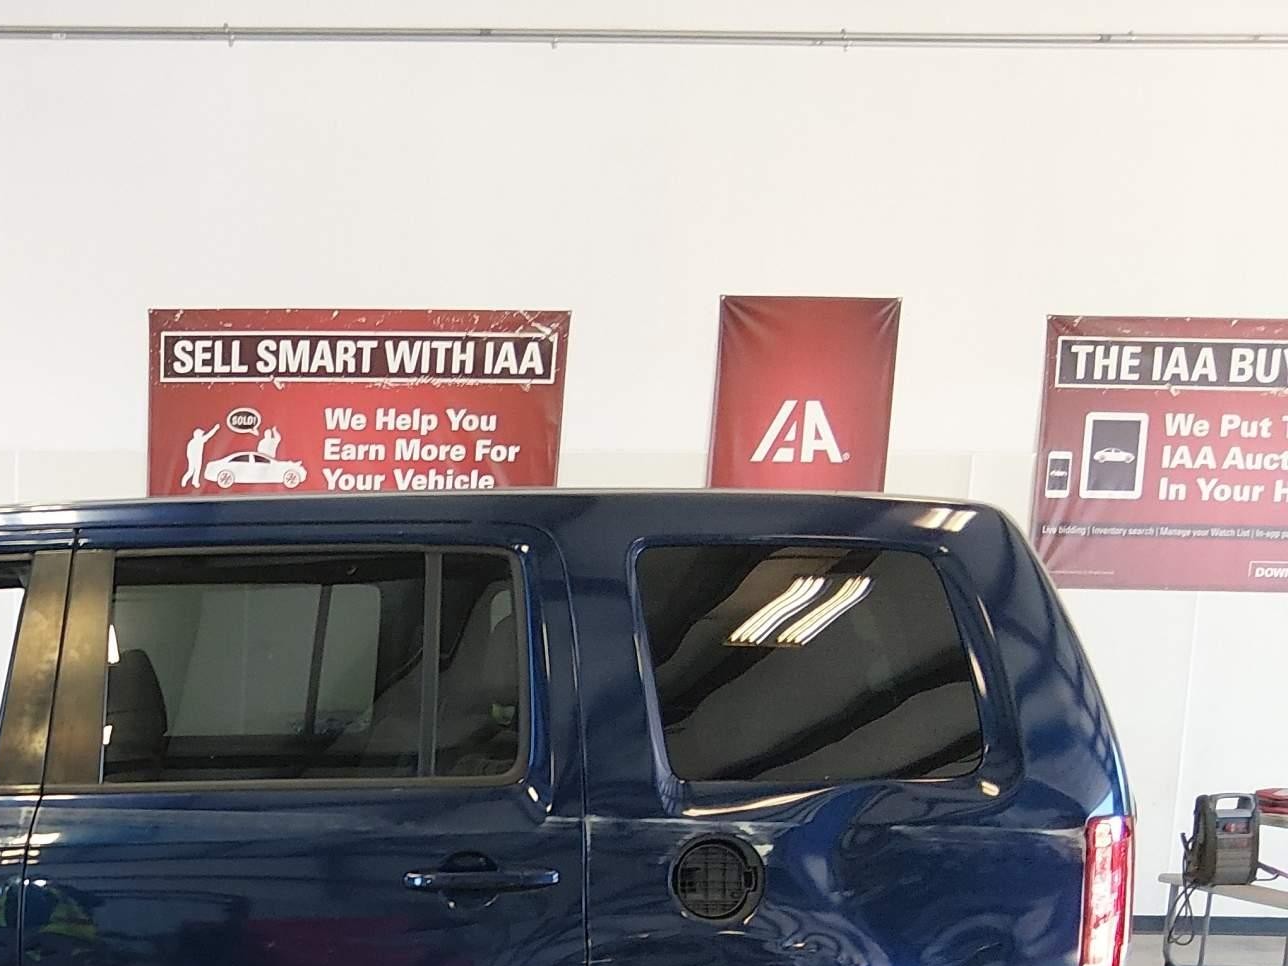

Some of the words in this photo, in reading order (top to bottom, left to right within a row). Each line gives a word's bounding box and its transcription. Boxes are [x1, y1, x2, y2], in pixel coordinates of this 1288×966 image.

[172, 339, 249, 374] SELL
[256, 339, 379, 374] SMART
[384, 340, 475, 374] WITH
[484, 341, 544, 375] IAA
[1070, 344, 1142, 381] THE
[1152, 346, 1217, 382] IAA
[231, 415, 257, 426] SOLD!
[324, 407, 367, 431] We
[375, 407, 439, 436] Help
[445, 408, 497, 432] You
[1164, 412, 1210, 437] We
[1220, 413, 1273, 438] Put
[323, 438, 386, 461] Earn
[394, 438, 466, 462] More
[475, 439, 520, 463] For
[1161, 445, 1216, 470] IAA
[322, 468, 386, 491] Your
[393, 468, 495, 491] Vehicle
[1158, 477, 1187, 501] In
[1196, 478, 1265, 502] Your
[1041, 525, 1057, 535] Live
[1058, 526, 1086, 536] bidding
[1092, 526, 1127, 536] Inventory
[1128, 526, 1154, 535] search
[1159, 527, 1191, 537] Manage
[1192, 529, 1209, 537] your
[1210, 528, 1235, 537] Watch
[1236, 529, 1251, 537] List
